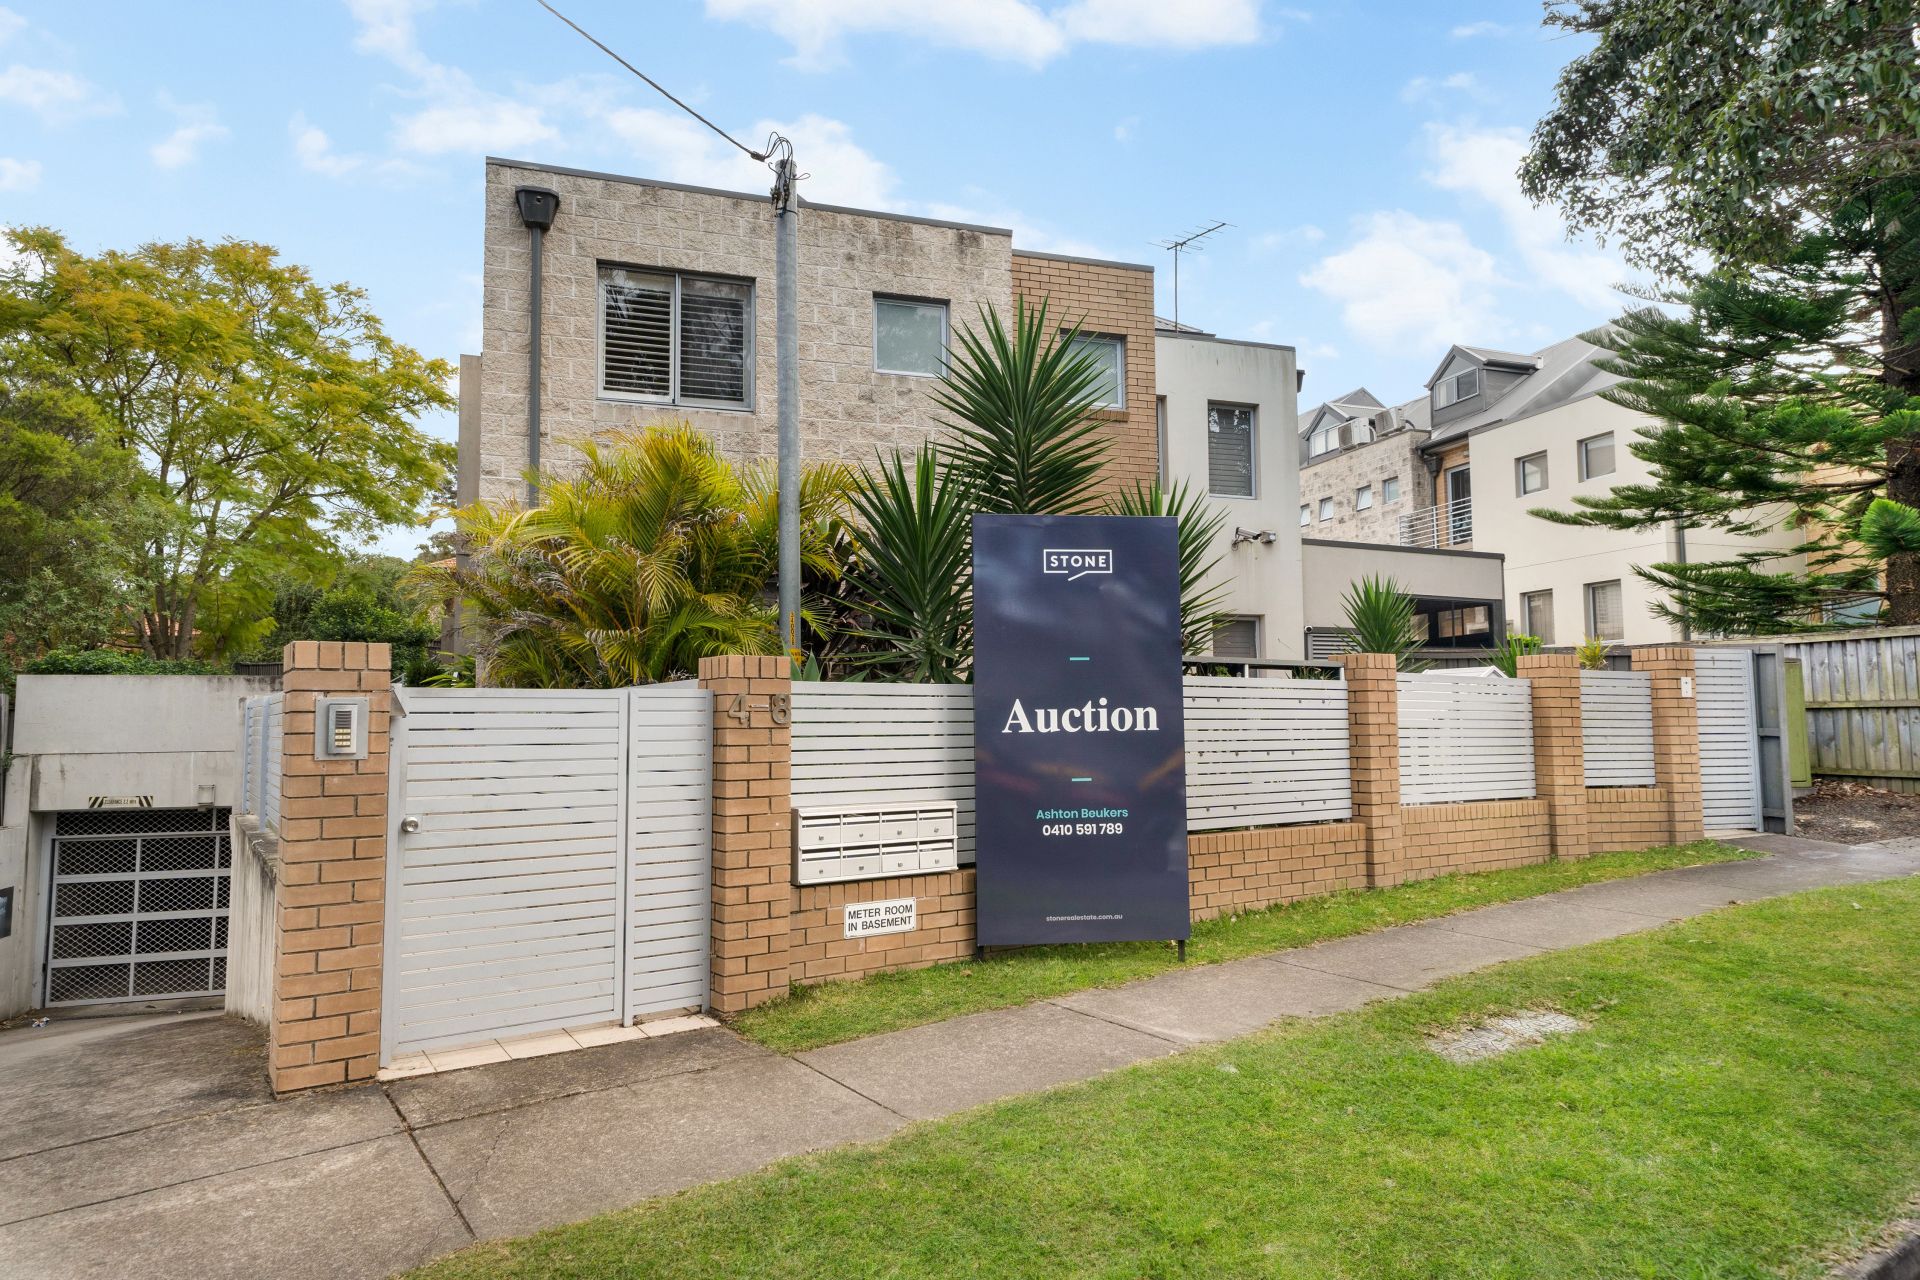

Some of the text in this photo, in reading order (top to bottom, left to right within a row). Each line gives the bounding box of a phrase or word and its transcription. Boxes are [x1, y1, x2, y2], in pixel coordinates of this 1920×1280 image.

[1050, 555, 1107, 568] STONE
[1001, 697, 1160, 733] Auction
[1036, 808, 1129, 819] Ashton Beukers
[1042, 822, 1123, 836] 0410 591 789
[848, 904, 913, 920] METER ROOM
[1046, 914, 1123, 922] stonerealestate.com.au
[848, 915, 912, 932] IN BASEMENT
